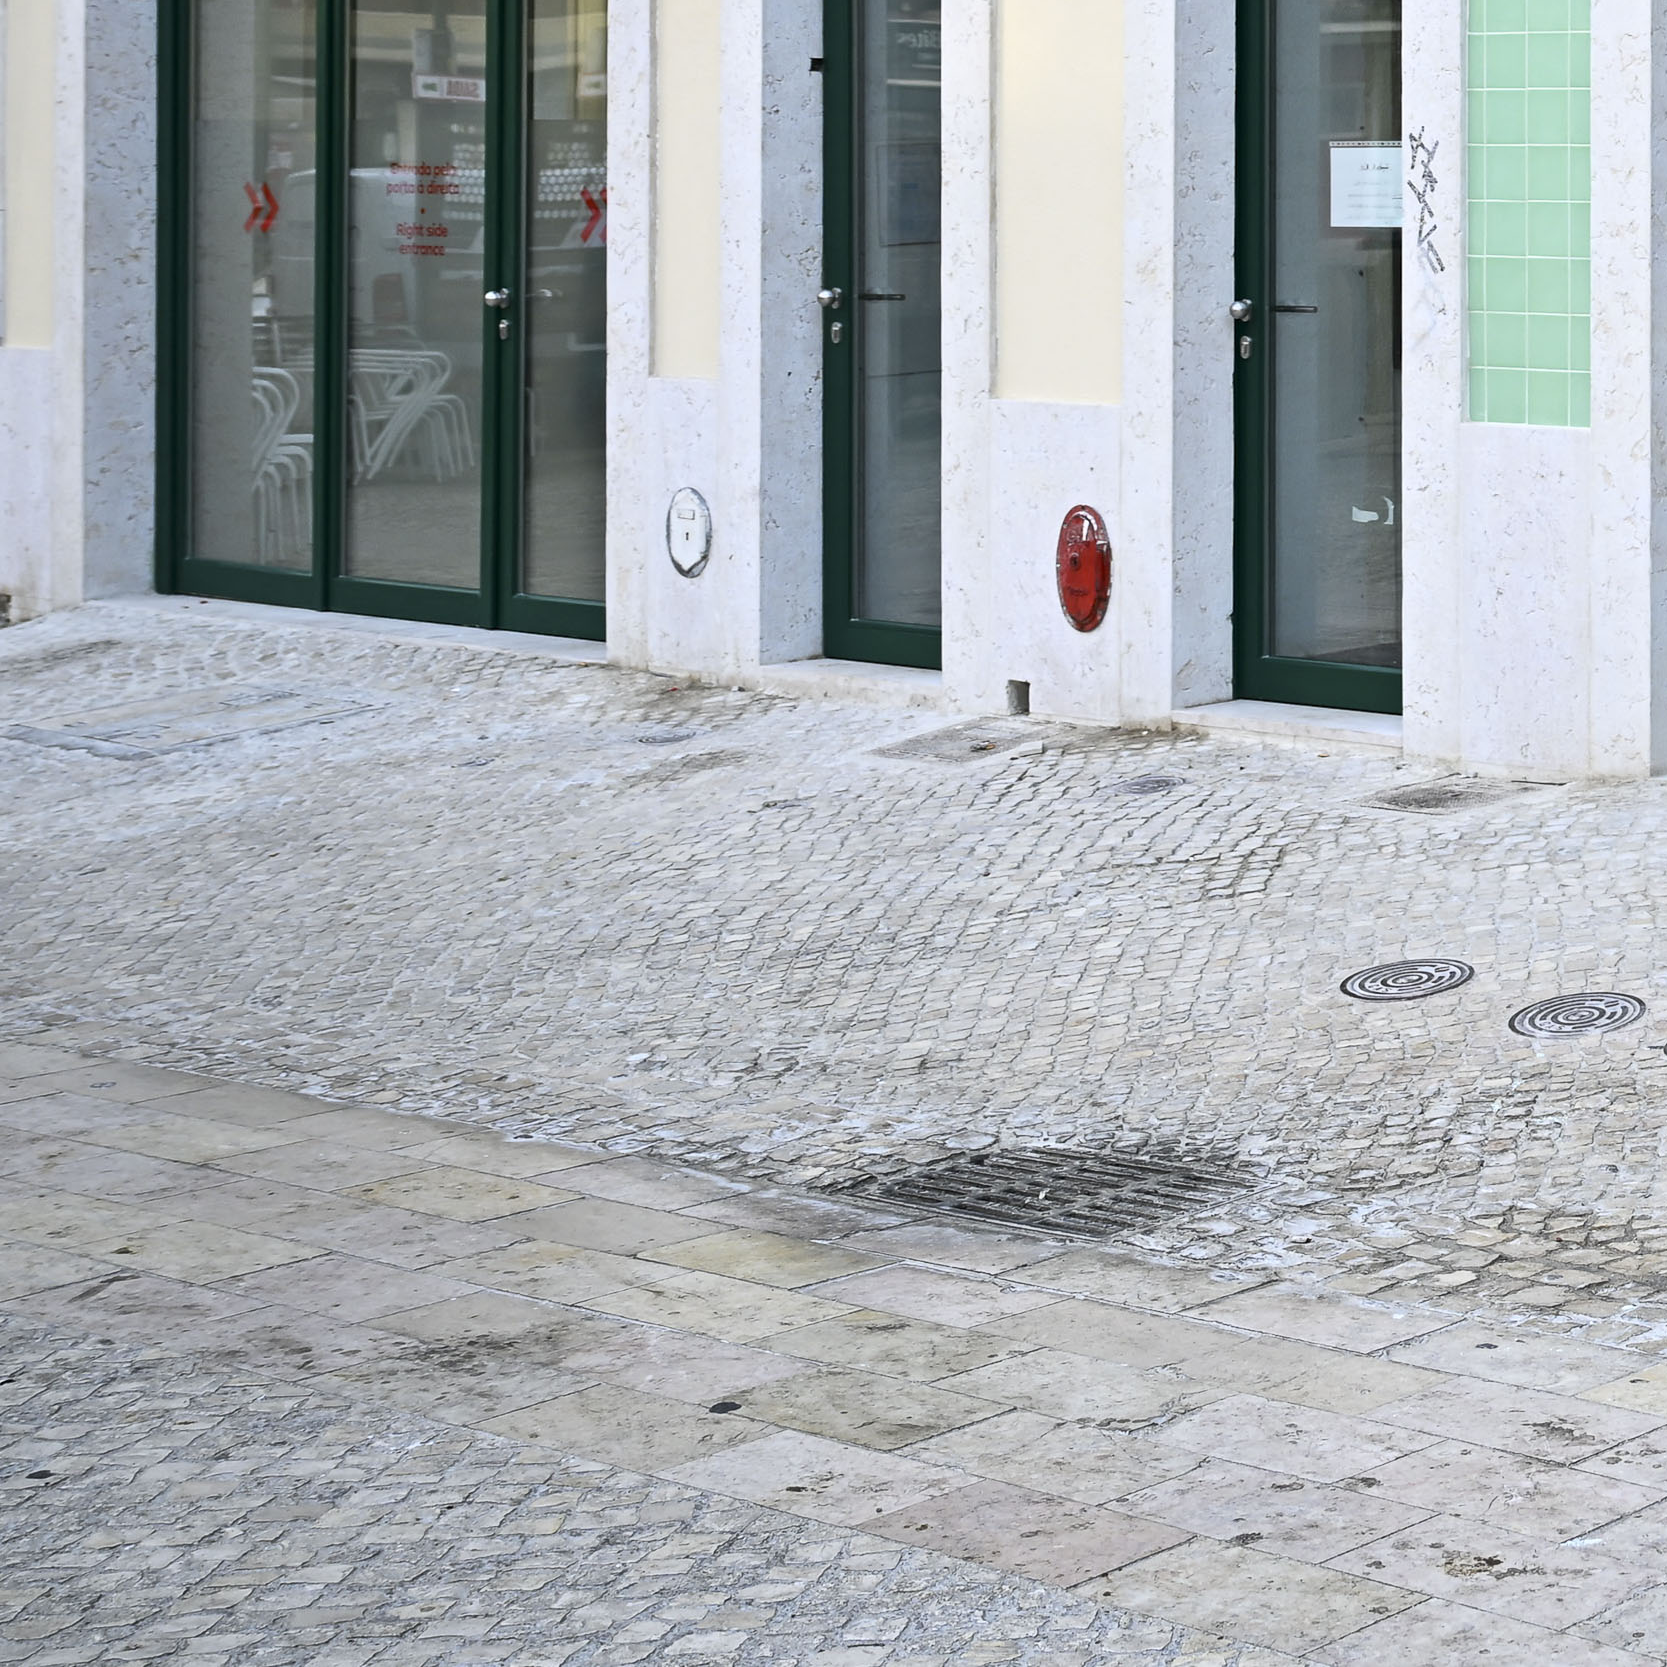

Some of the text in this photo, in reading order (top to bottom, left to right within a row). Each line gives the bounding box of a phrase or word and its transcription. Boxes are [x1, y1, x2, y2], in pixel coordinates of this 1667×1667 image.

[396, 223, 448, 239] Right side
[399, 243, 446, 256] entrance
